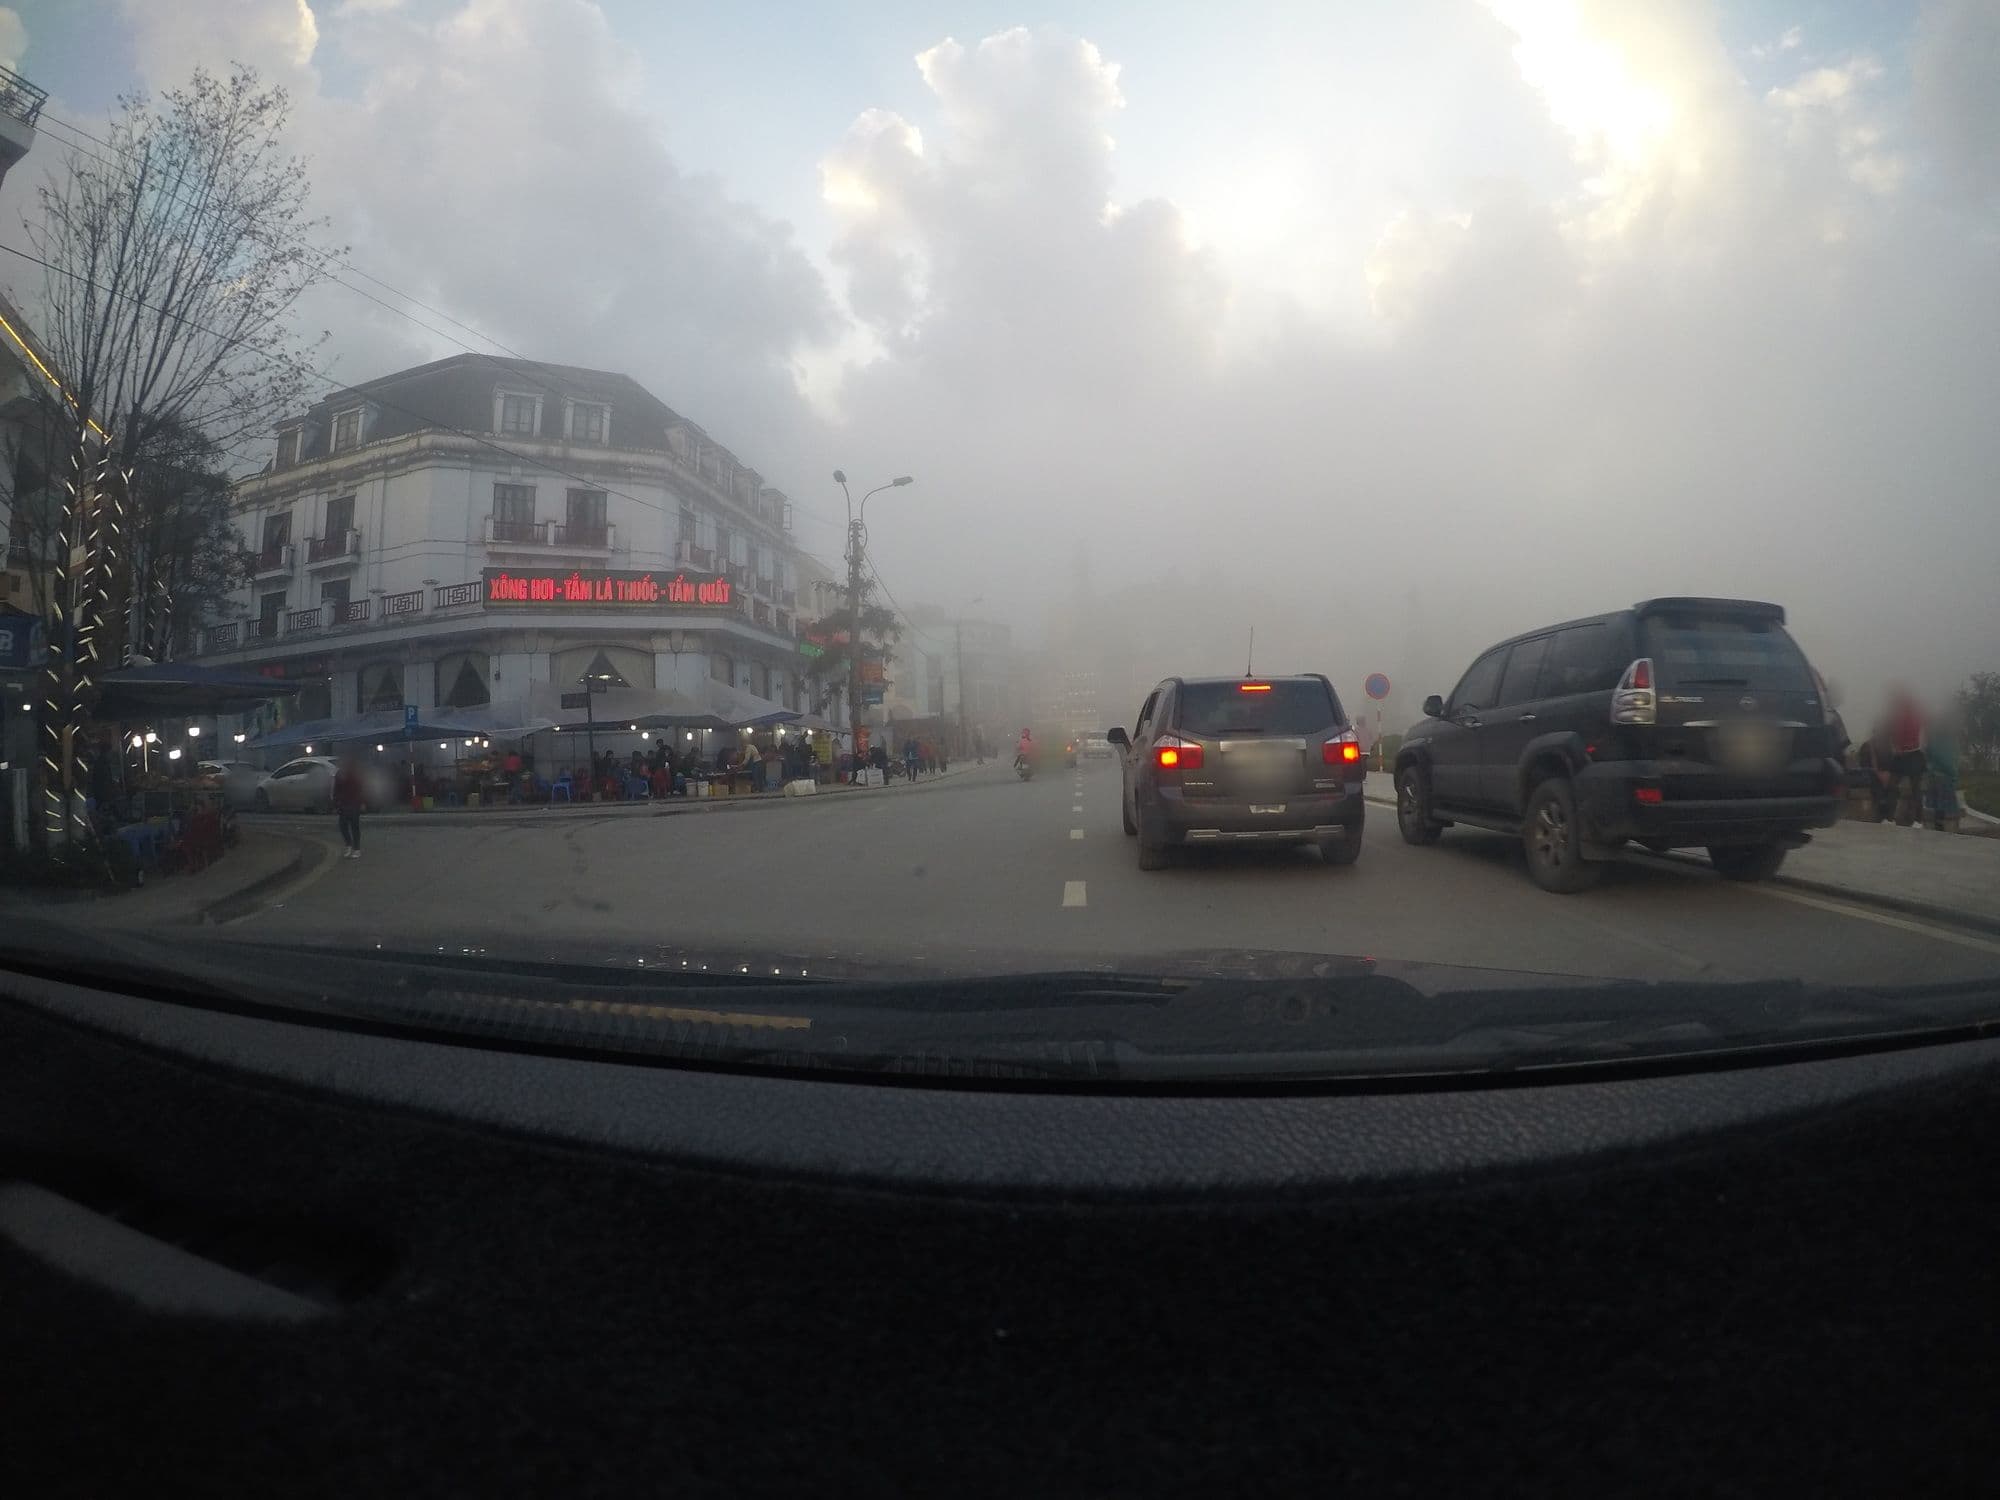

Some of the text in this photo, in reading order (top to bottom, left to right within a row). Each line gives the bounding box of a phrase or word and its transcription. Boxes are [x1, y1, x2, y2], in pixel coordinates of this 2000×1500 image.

[490, 574, 528, 600] XÔNG
[531, 577, 554, 600] HƠI
[564, 572, 593, 600] TẮM
[596, 576, 613, 601] LÁ
[617, 574, 658, 601] THUỐC
[698, 577, 730, 604] QUẤT
